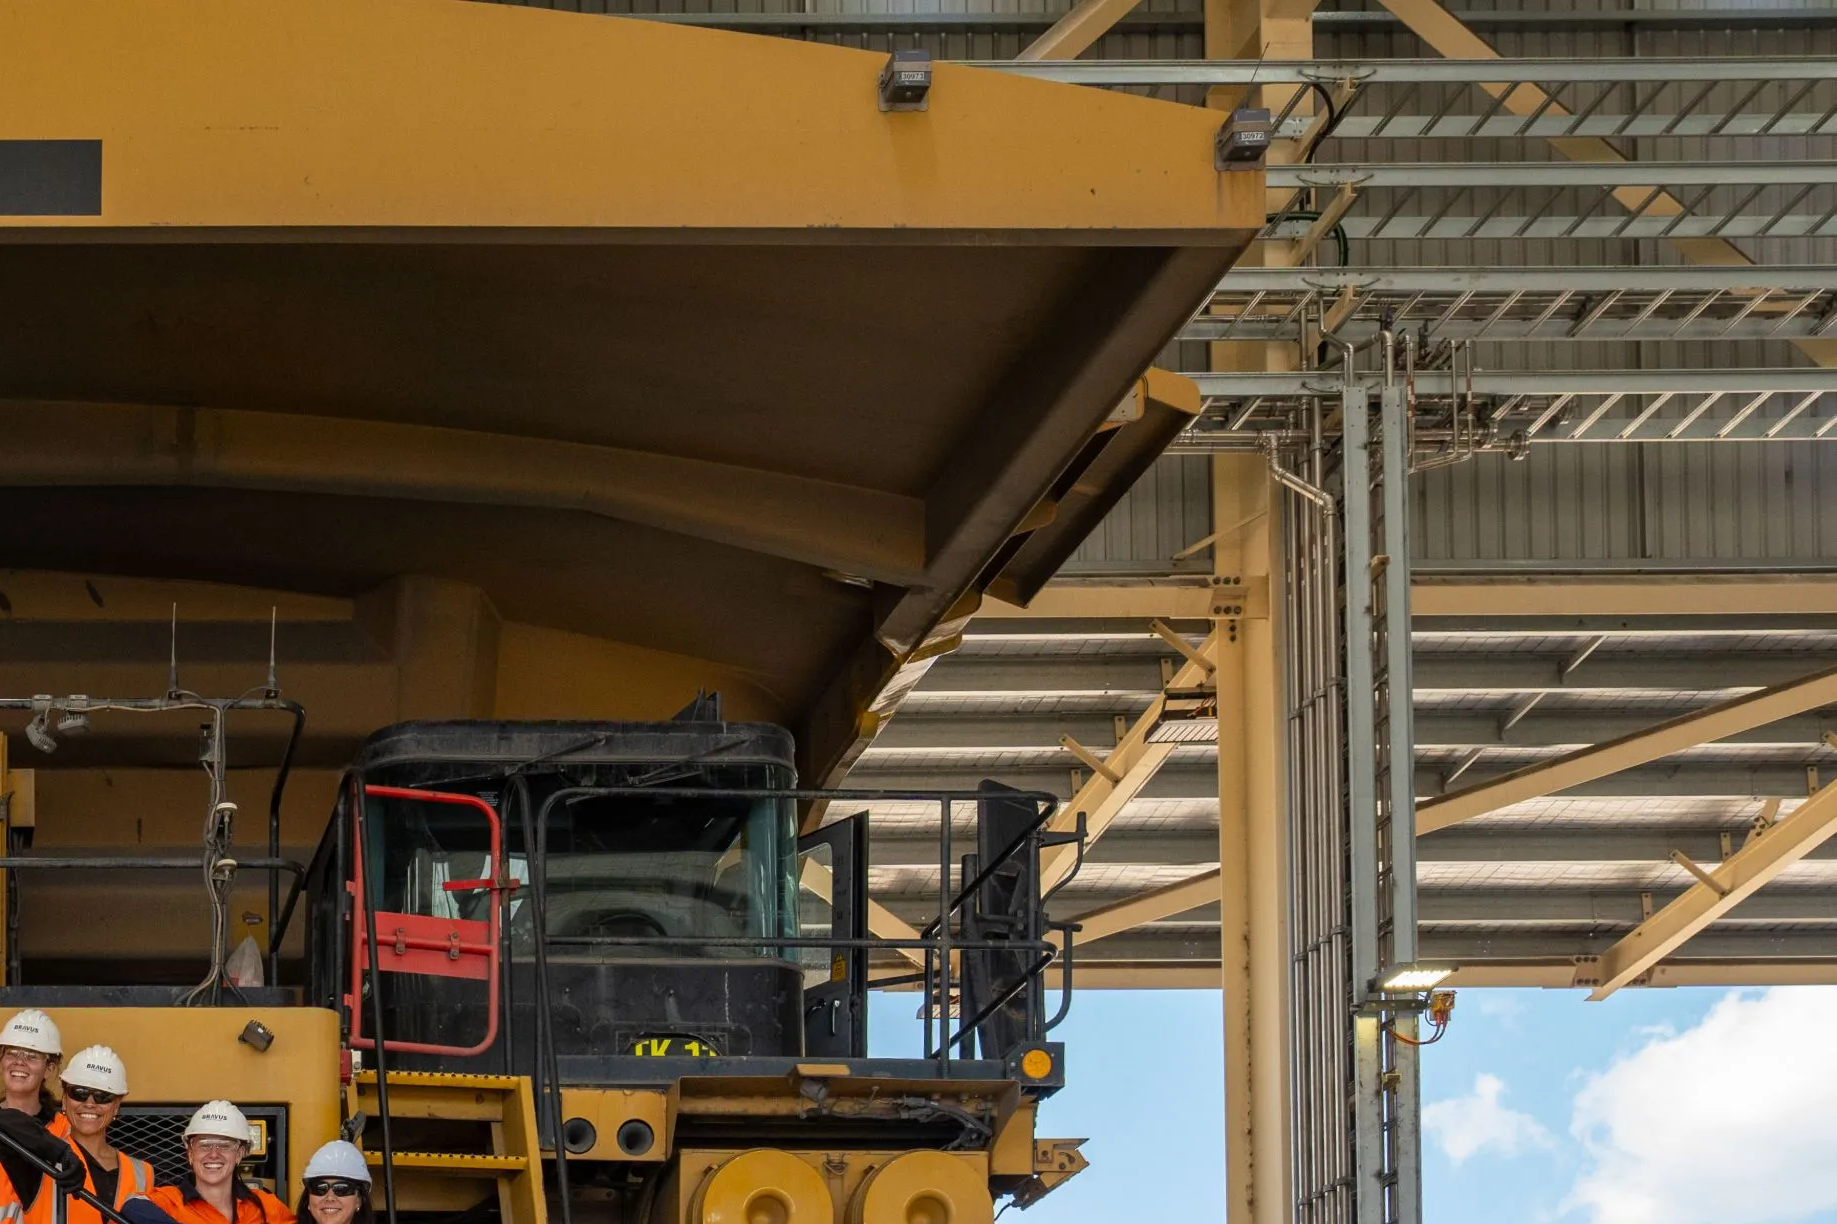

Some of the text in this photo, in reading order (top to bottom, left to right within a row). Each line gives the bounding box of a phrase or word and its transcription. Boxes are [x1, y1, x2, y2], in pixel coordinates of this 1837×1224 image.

[1243, 132, 1263, 140] 30972
[14, 1024, 39, 1034] BRAVUS
[86, 1063, 112, 1074] BRAVUS
